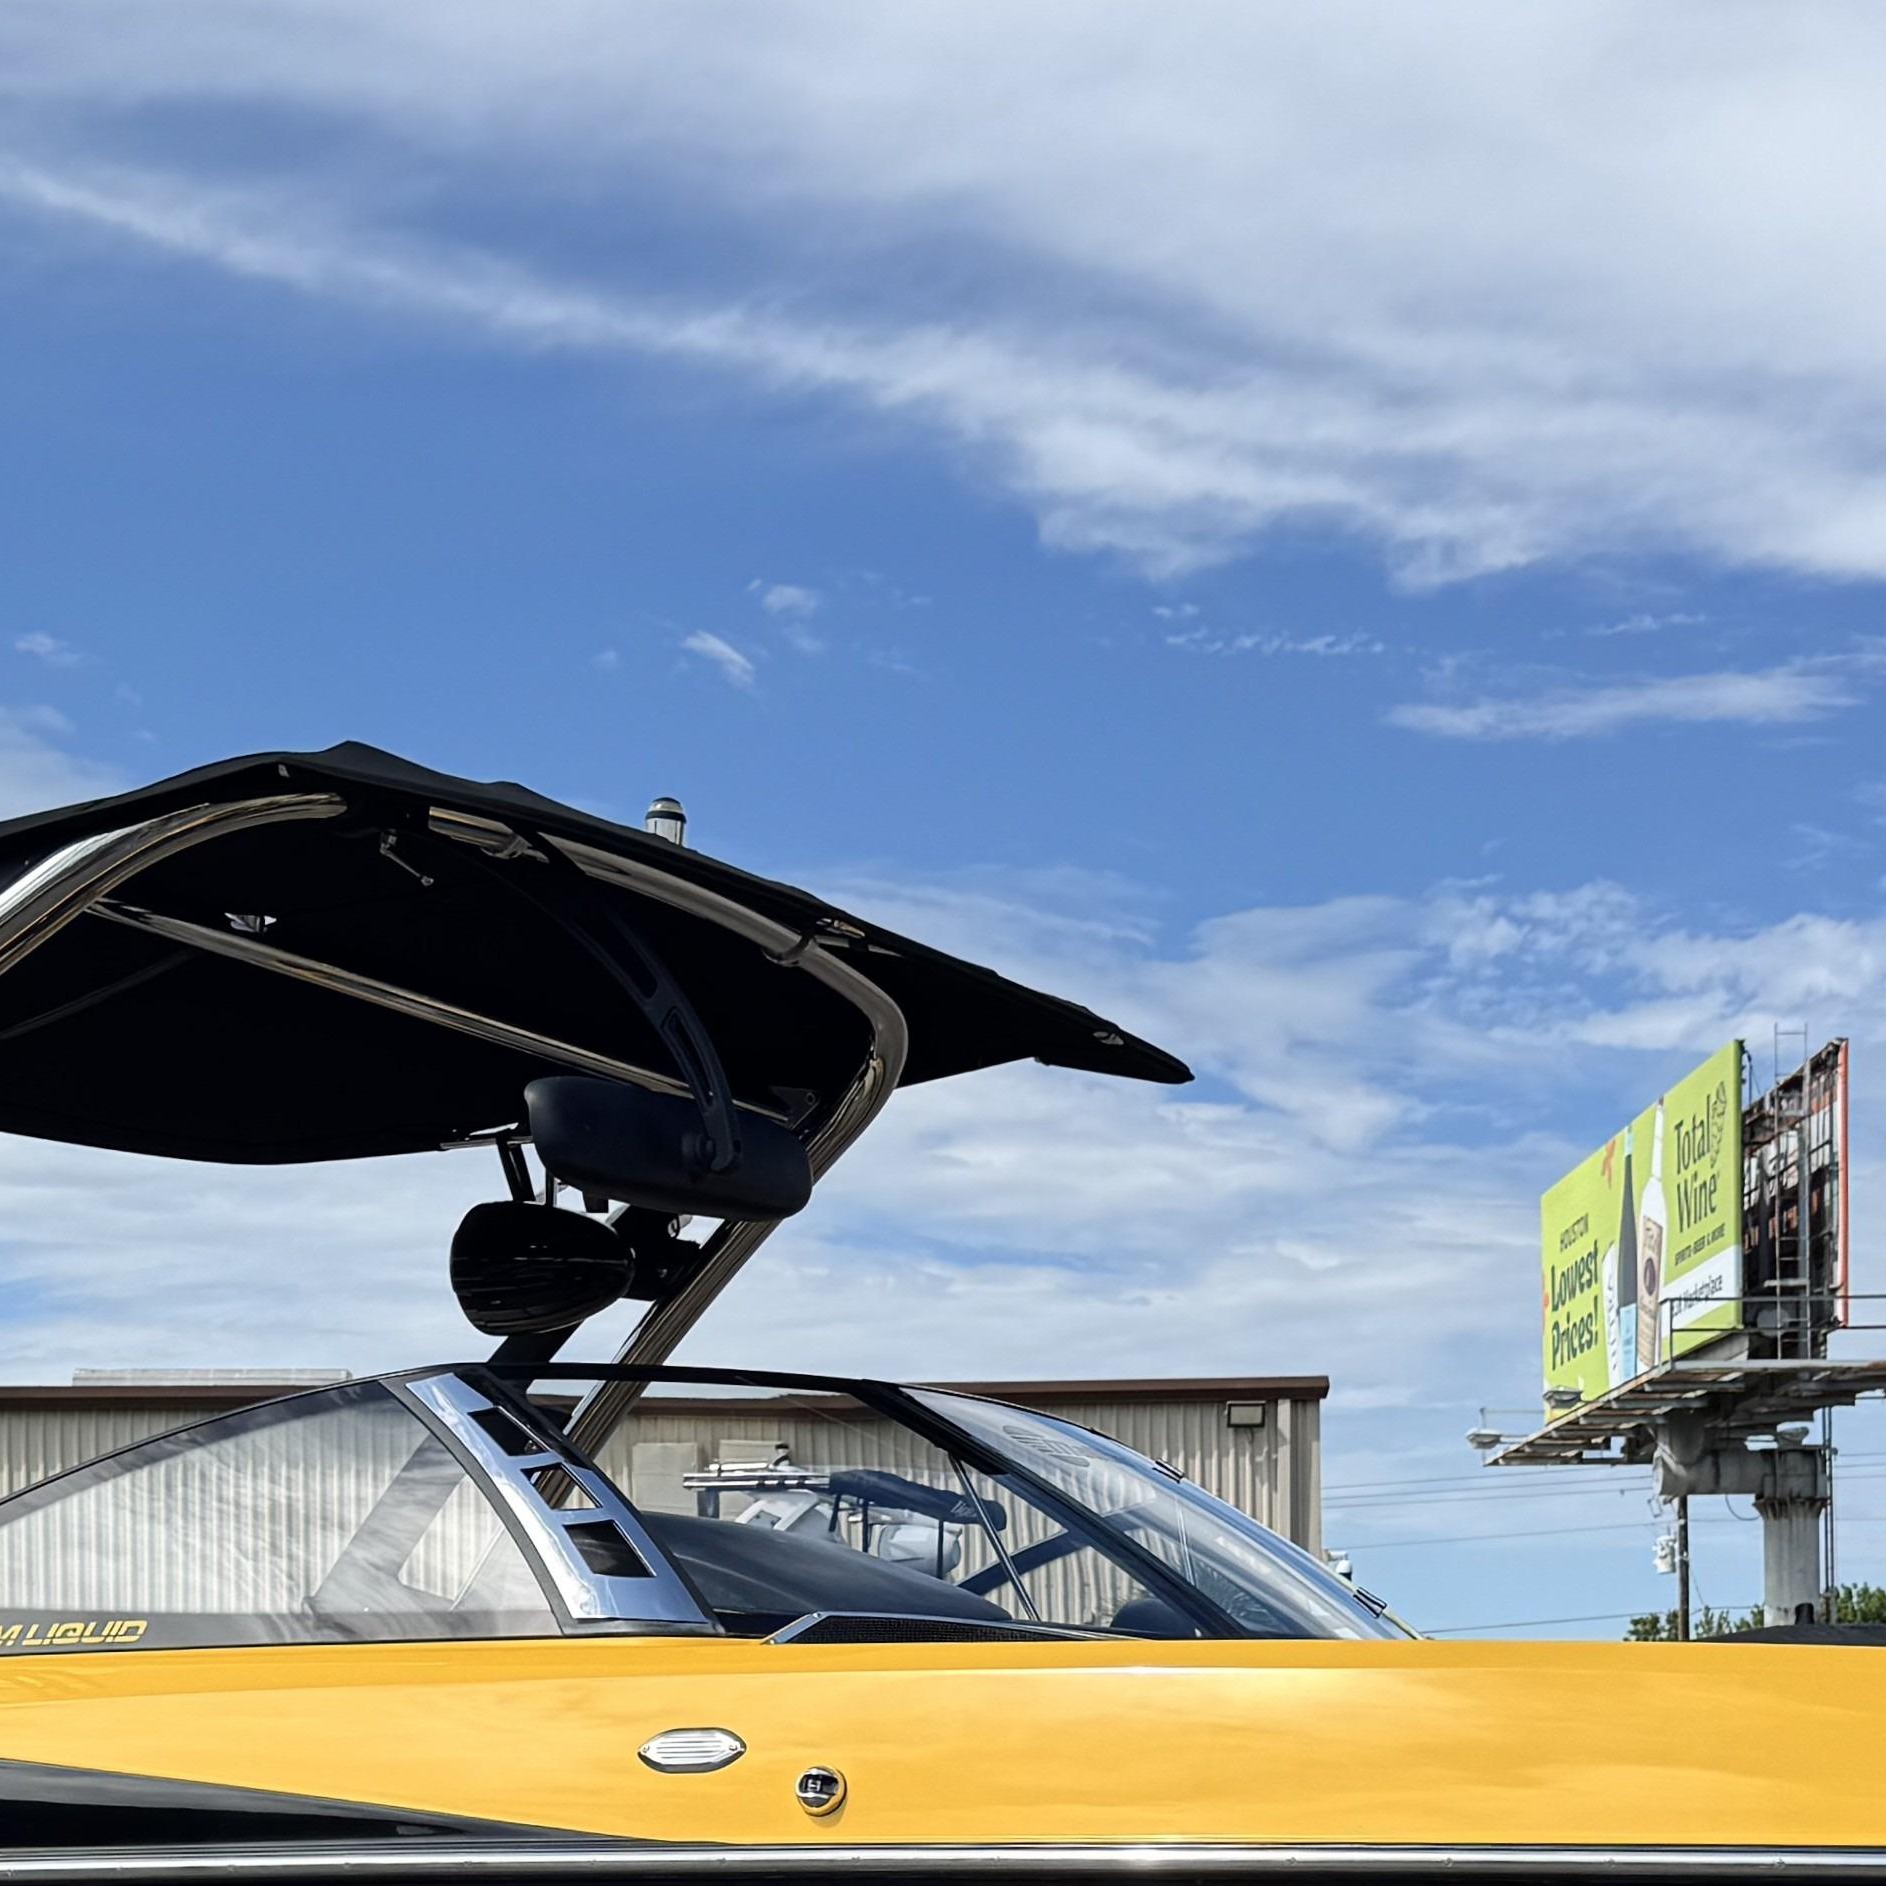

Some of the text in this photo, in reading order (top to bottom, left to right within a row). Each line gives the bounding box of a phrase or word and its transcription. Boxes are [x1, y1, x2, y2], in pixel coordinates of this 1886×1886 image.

[1674, 1094, 1711, 1175] Total
[1677, 1171, 1717, 1233] Wine
[1551, 1239, 1598, 1312] Lowest
[1552, 1295, 1598, 1371] Prices!
[23, 1620, 148, 1646] LIQUID
